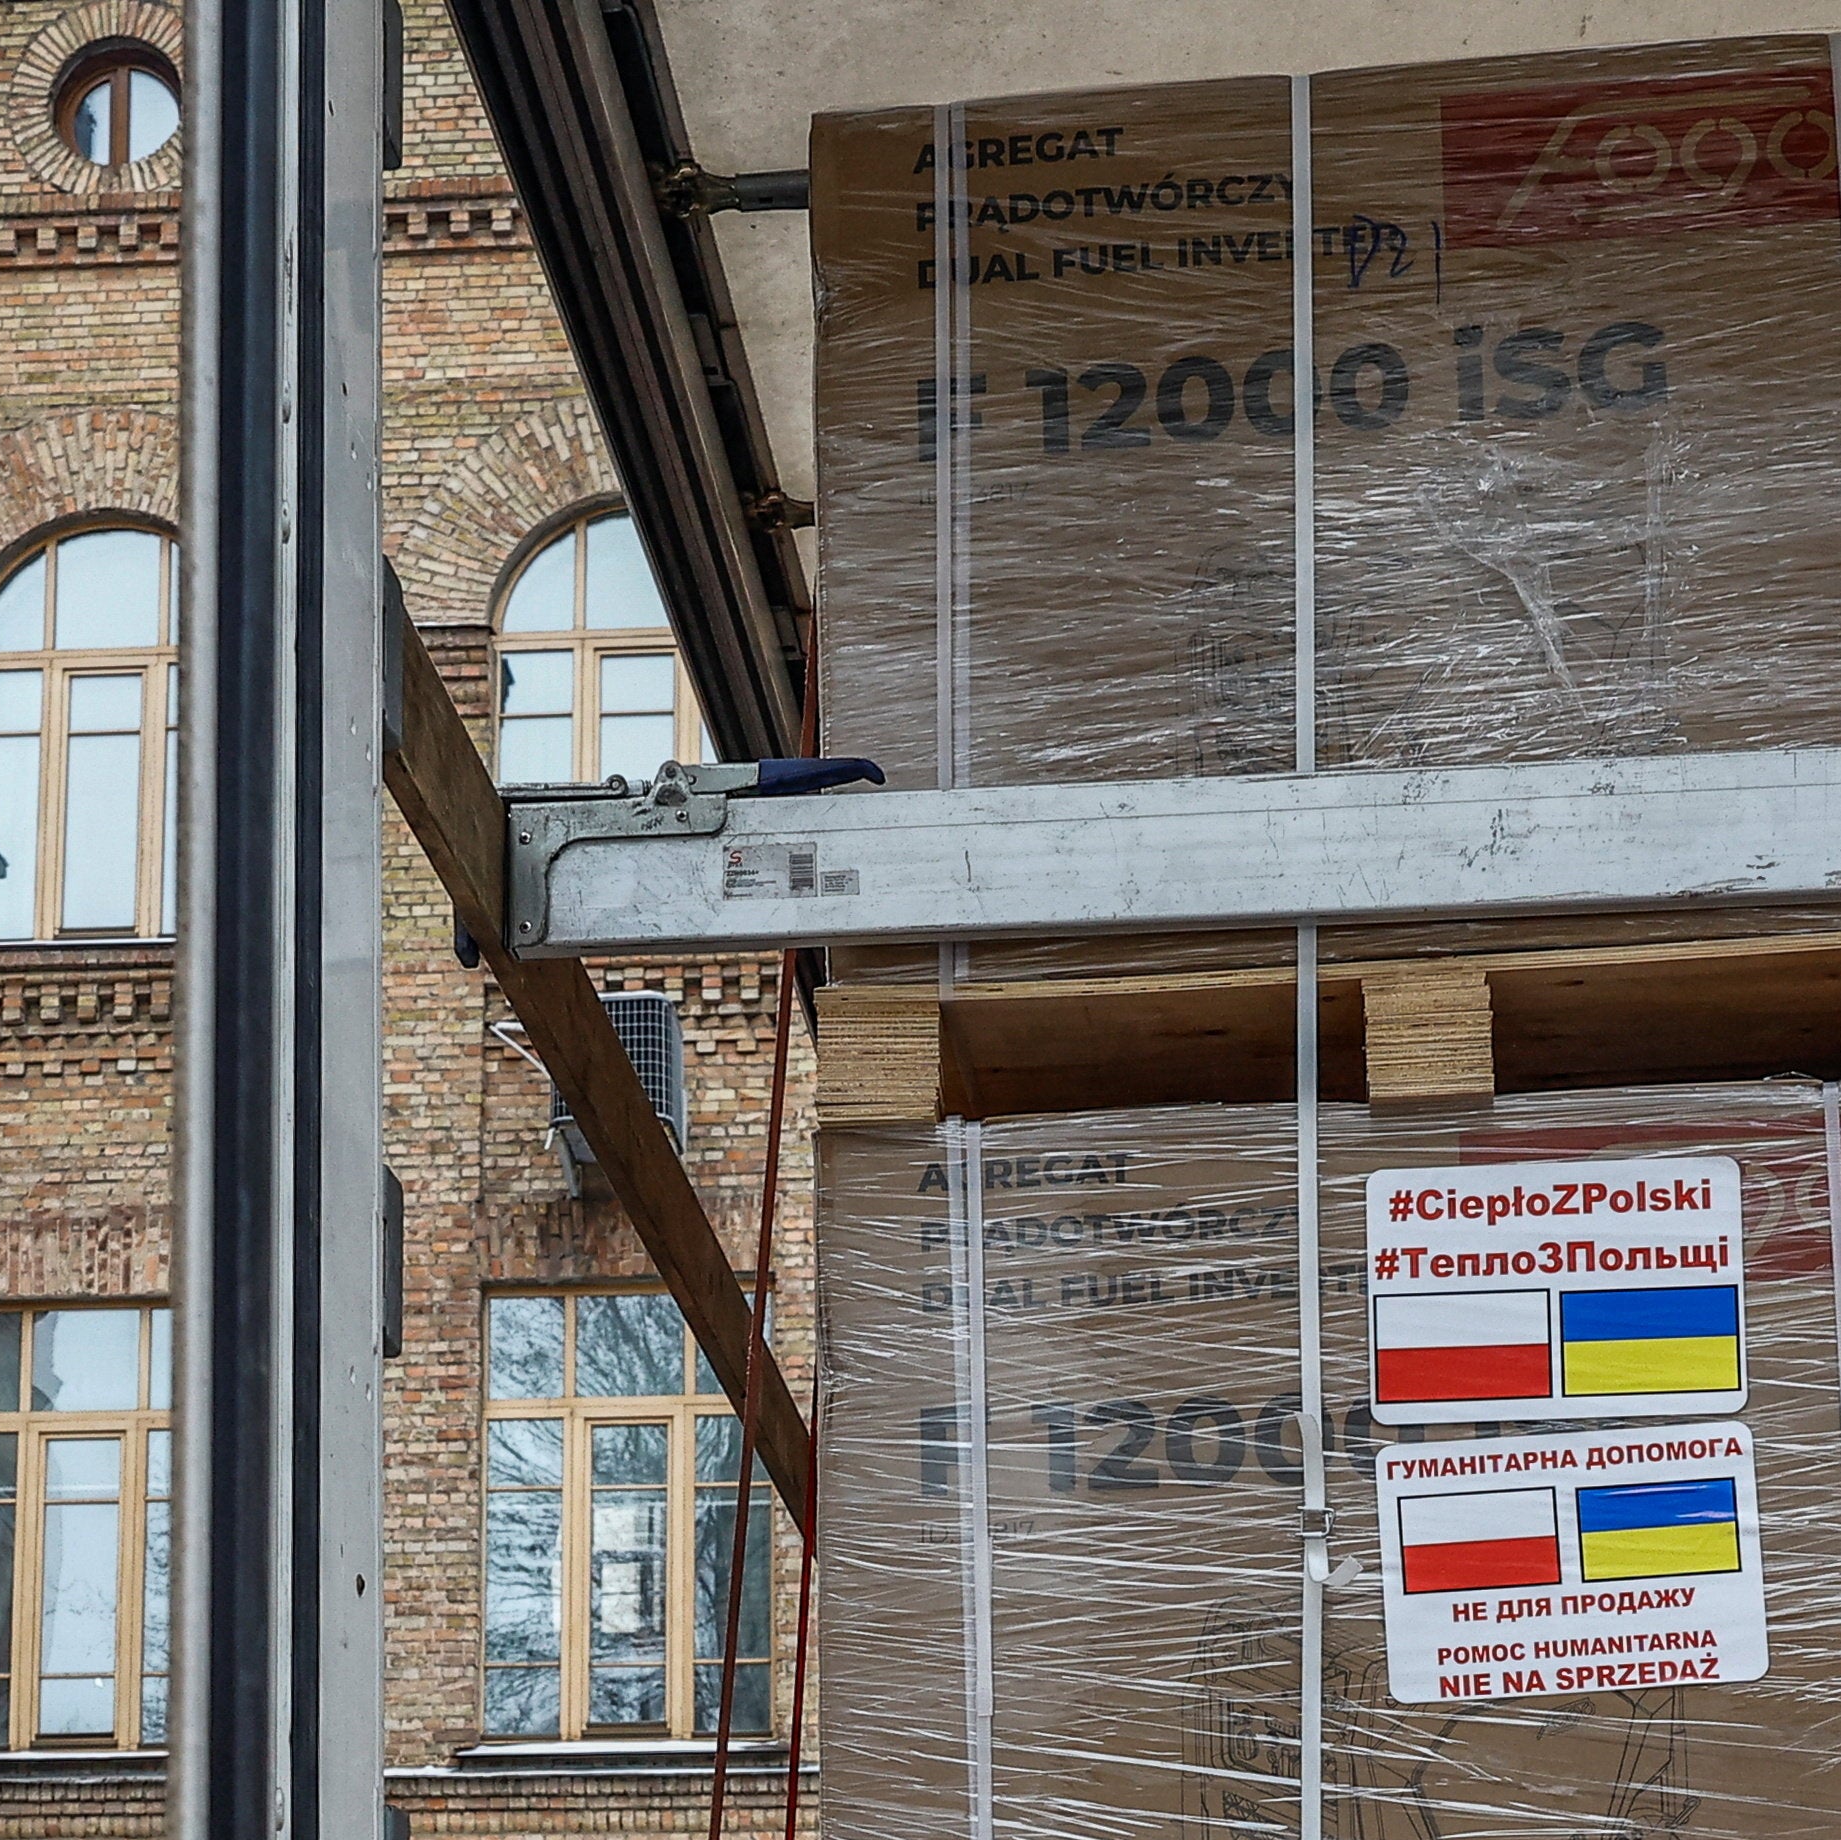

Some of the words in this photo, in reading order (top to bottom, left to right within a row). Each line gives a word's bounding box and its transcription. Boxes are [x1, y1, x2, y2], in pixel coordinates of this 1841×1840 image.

[1052, 240, 1165, 279] FUEL
[1025, 341, 1409, 455] 12000
[1454, 321, 1667, 423] iSG
[1389, 1179, 1712, 1226] #CiepłoZPolski
[1374, 1236, 1730, 1281] #ТеплоЗПольщі
[1058, 1272, 1164, 1306] FUEL
[1386, 1448, 1578, 1481] ГУМАНІТАРНА
[1585, 1436, 1744, 1471] ДОПОМОГА
[1451, 1601, 1488, 1624] НЕ
[1496, 1597, 1553, 1623] ДЛЯ
[1560, 1587, 1696, 1617] ПРОДАЖУ
[1436, 1641, 1526, 1667] POMOC
[1533, 1629, 1718, 1660] HUMANITARNA
[1438, 1672, 1492, 1699] NIE
[1502, 1668, 1547, 1695] NA
[1555, 1652, 1721, 1692] SPRZEDAŻ
